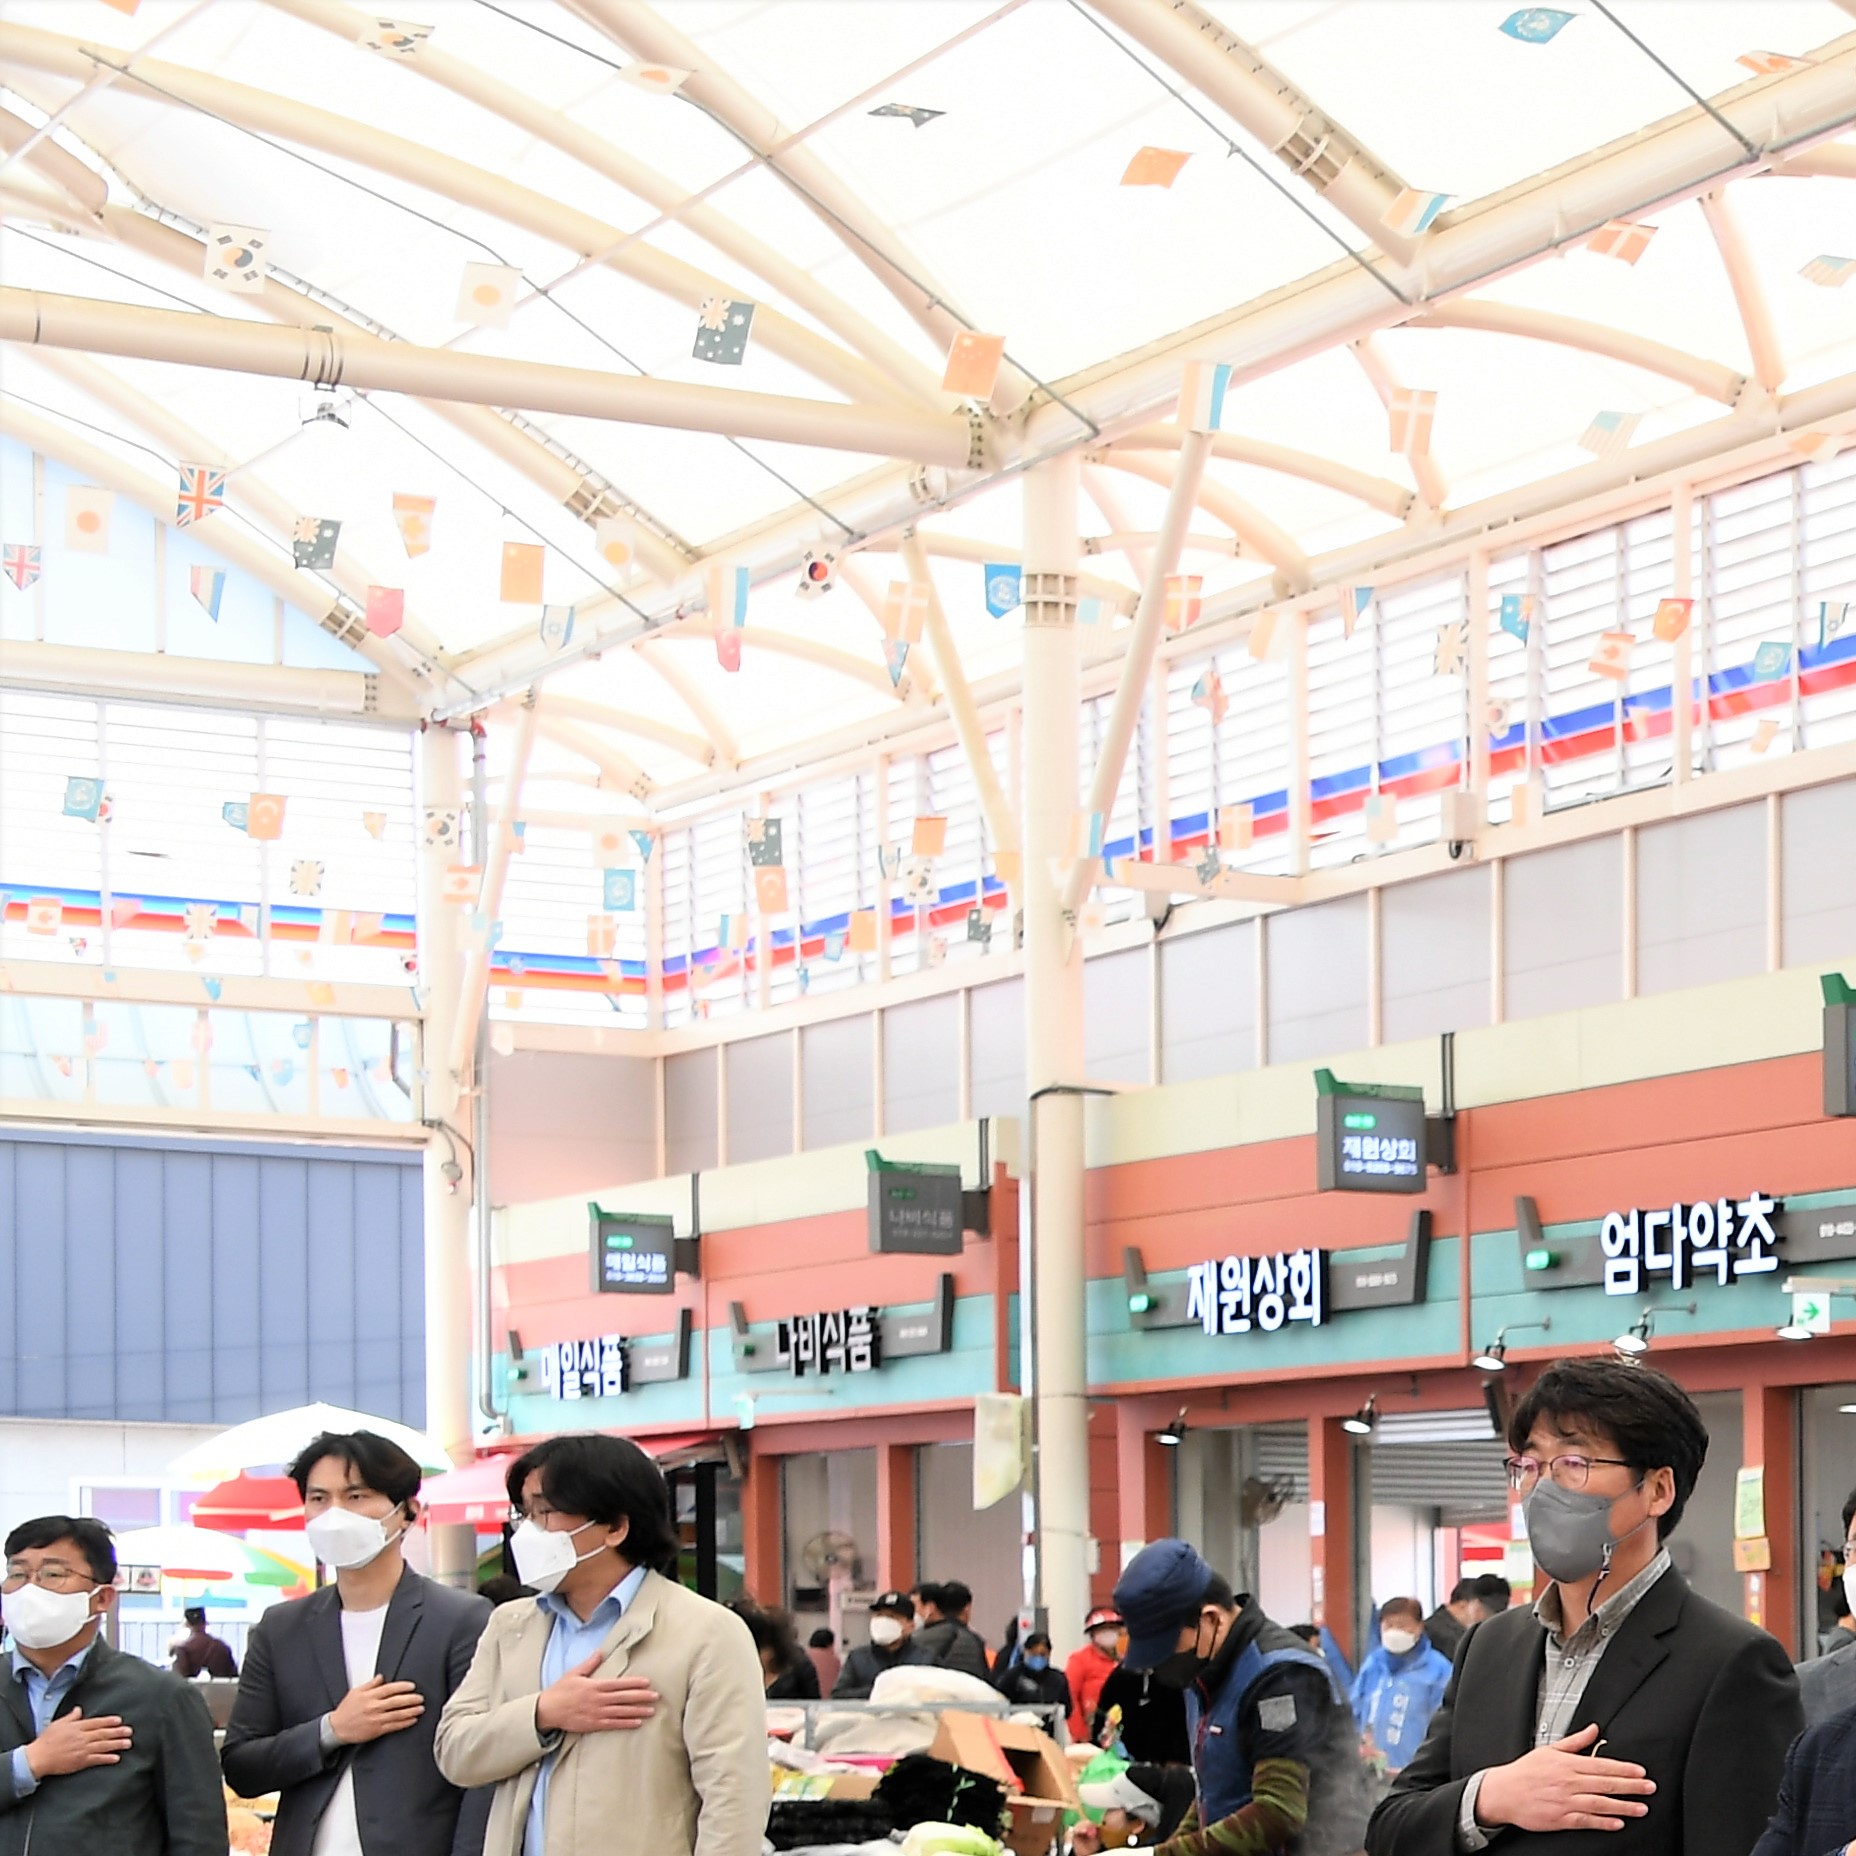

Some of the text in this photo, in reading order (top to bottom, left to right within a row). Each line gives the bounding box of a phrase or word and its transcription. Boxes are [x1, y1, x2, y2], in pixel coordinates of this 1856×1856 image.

[1343, 1136, 1417, 1162] 재원상회
[1600, 1190, 1780, 1297] 엄다약초
[1186, 1247, 1322, 1336] 재원상회
[541, 1332, 623, 1401] 매일식품
[776, 1305, 872, 1377] 나비식품
